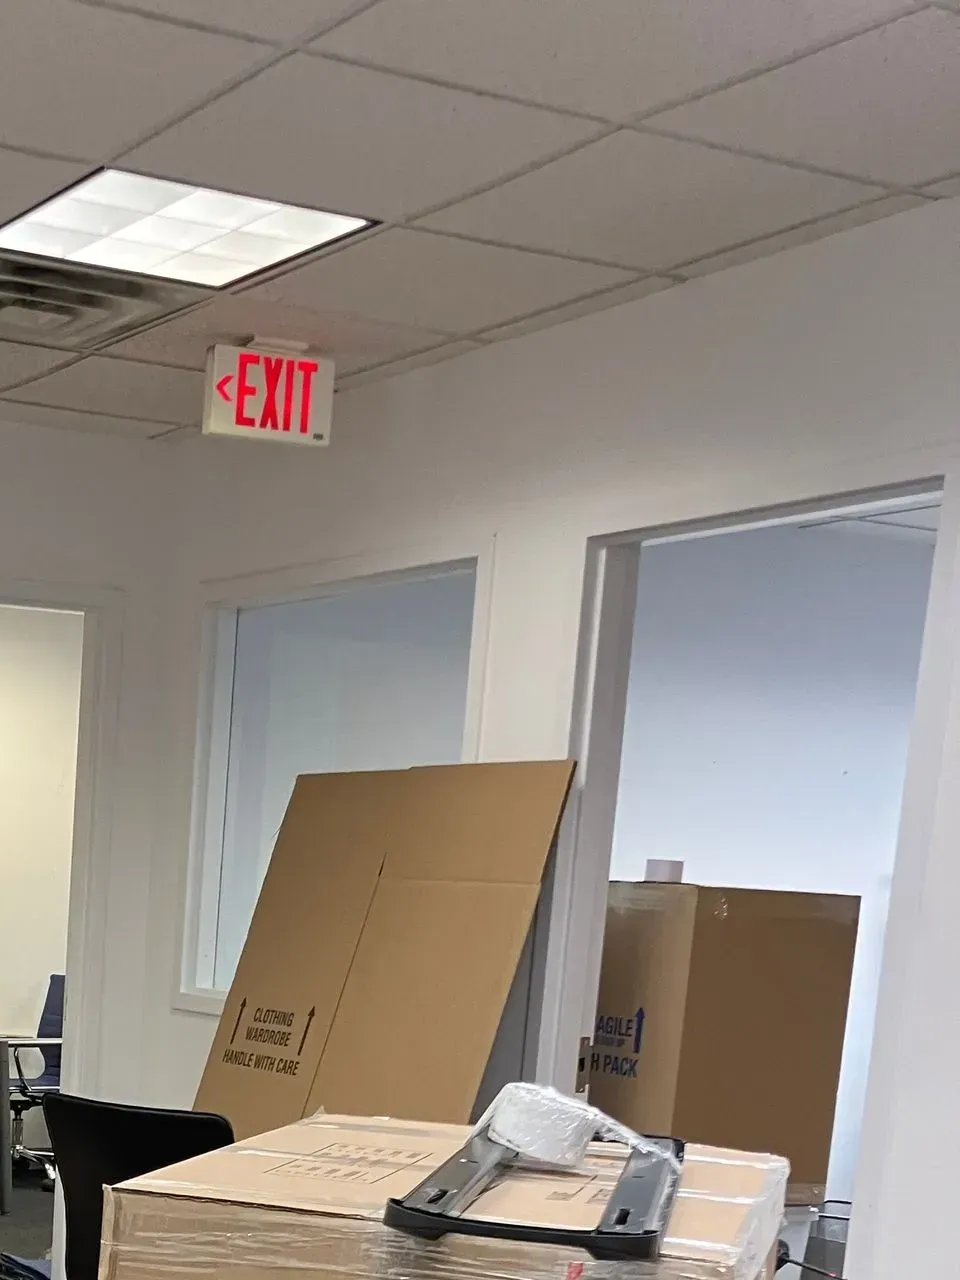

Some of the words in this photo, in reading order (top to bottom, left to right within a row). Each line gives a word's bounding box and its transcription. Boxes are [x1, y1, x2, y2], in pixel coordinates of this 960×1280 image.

[235, 353, 319, 434] EXIT
[253, 1007, 295, 1027] CLOTHING
[596, 1015, 633, 1037] AGILE
[245, 1026, 292, 1047] WARDROBE
[222, 1048, 255, 1068] HANDLE
[253, 1054, 277, 1072] WITH
[276, 1058, 301, 1076] CARE
[602, 1054, 640, 1078] PACK
